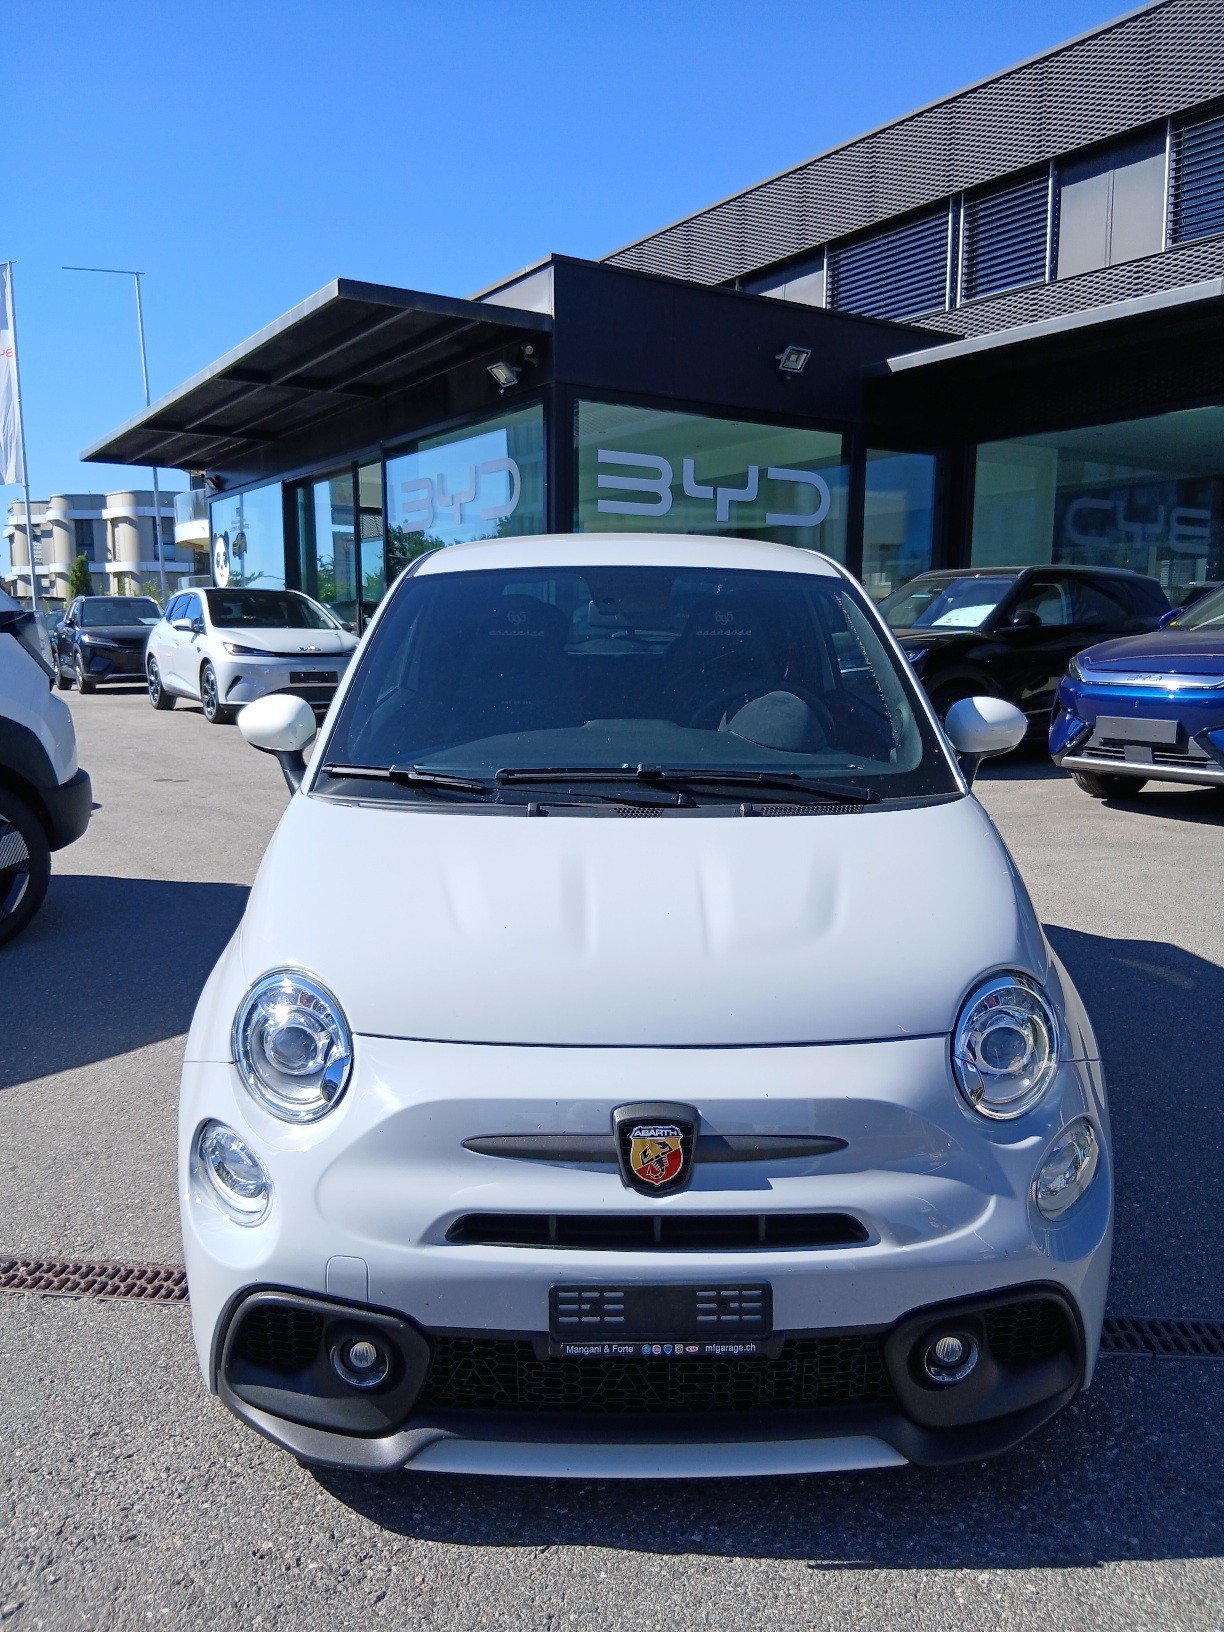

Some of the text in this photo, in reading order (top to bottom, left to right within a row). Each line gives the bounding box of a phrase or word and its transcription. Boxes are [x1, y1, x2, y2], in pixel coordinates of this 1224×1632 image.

[401, 457, 520, 533] BYD
[598, 449, 830, 527] BYD
[714, 610, 733, 626] 695
[634, 1129, 676, 1137] ABARTH
[566, 1344, 634, 1355] Mangani & Forte
[705, 1343, 756, 1355] mfgarage.ch
